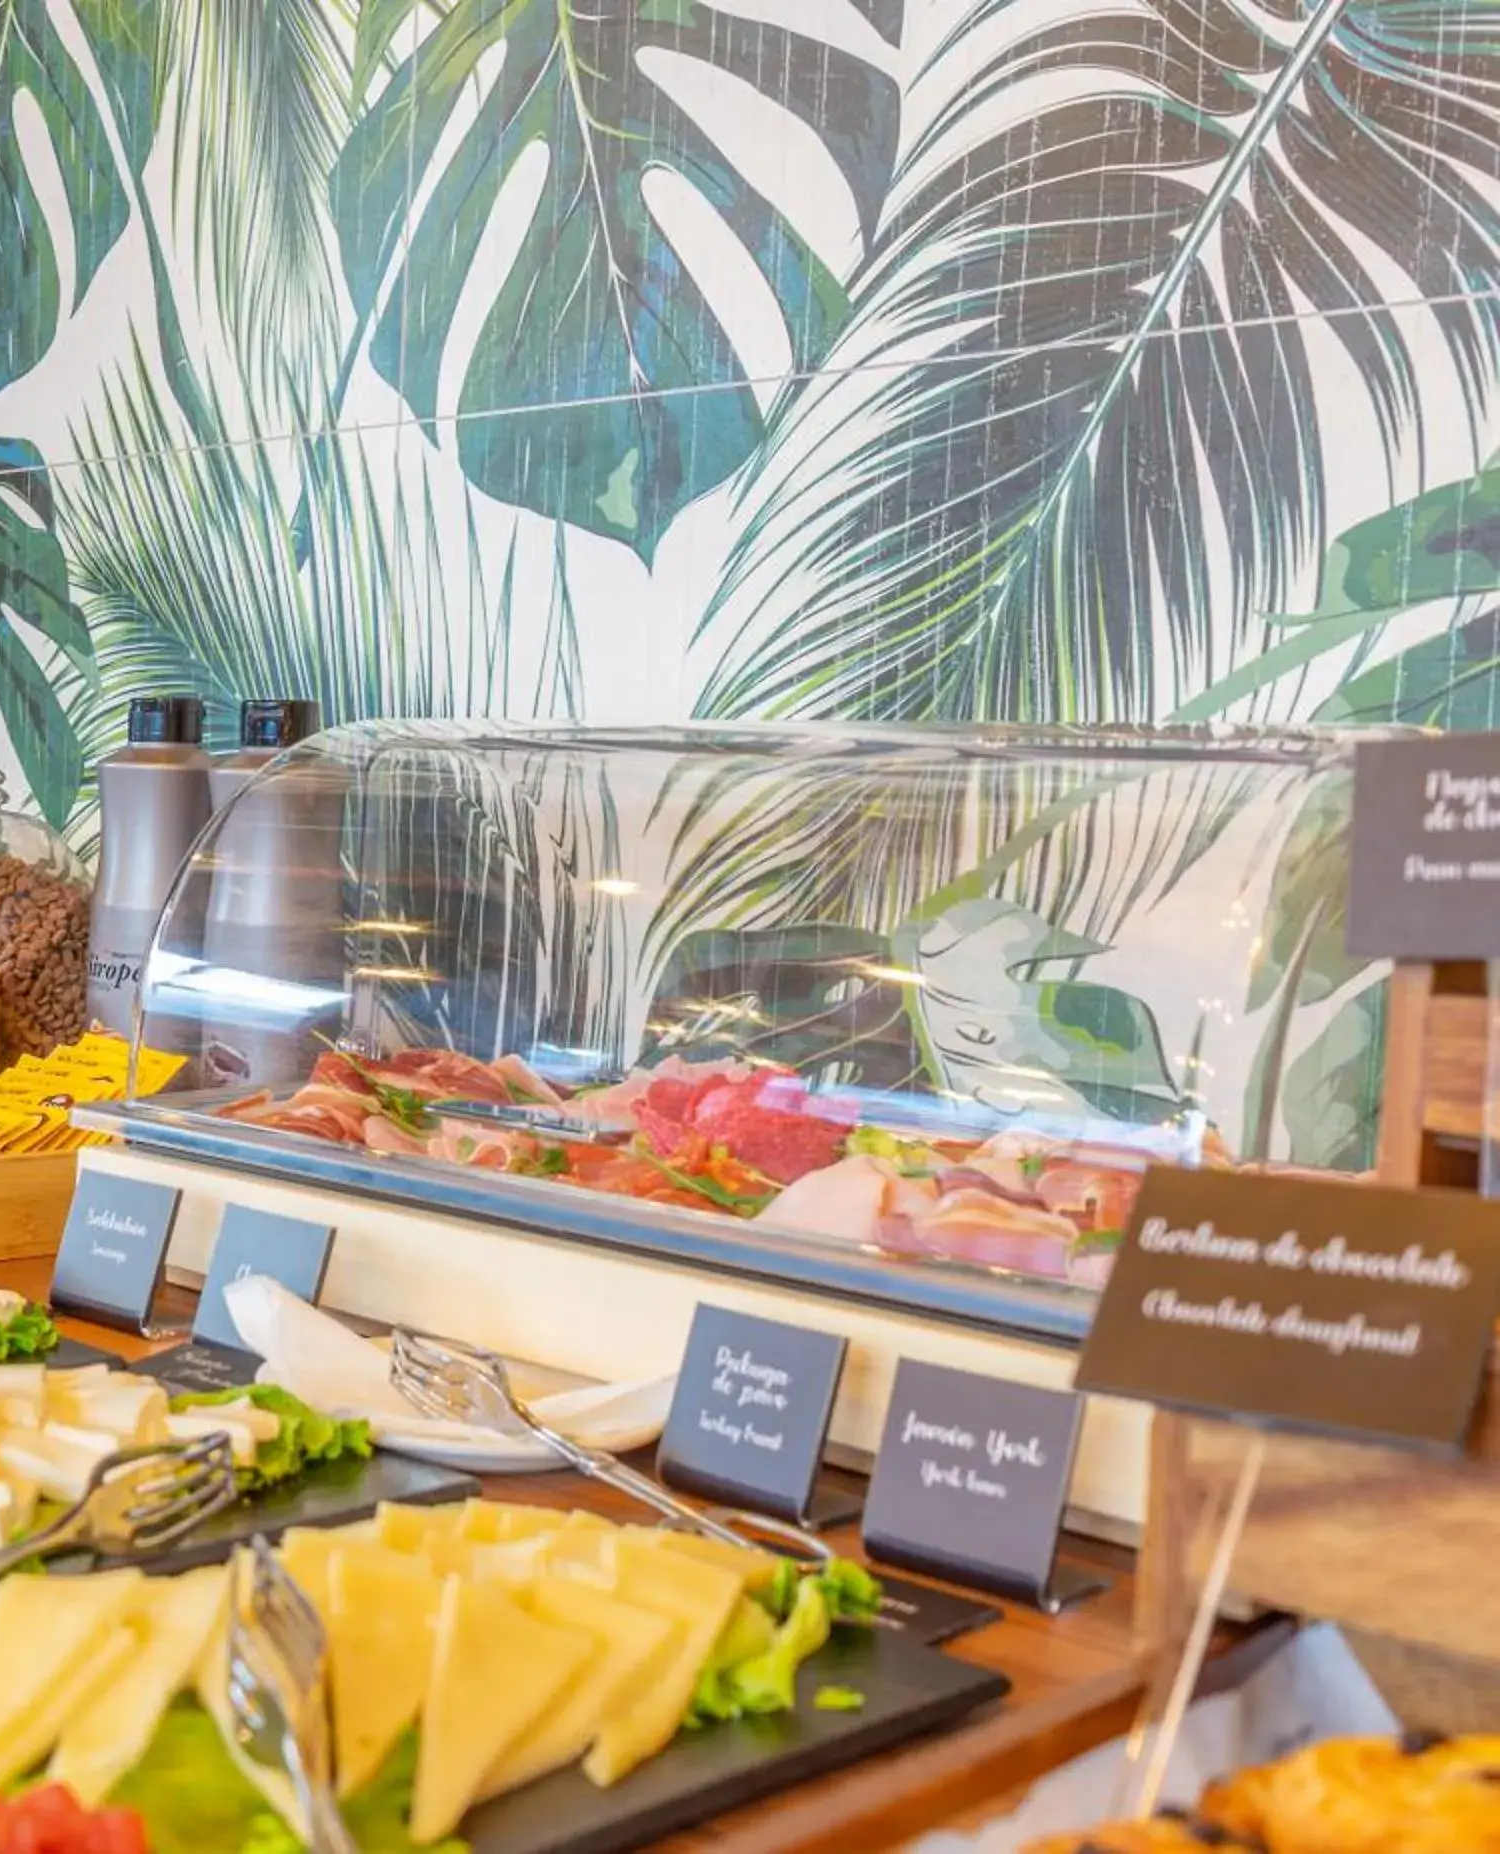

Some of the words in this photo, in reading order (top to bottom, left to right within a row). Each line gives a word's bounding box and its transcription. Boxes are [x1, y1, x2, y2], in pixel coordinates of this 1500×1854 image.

[1263, 1229, 1308, 1271] de
[1309, 1236, 1472, 1291] chocolate
[1141, 1288, 1268, 1334] Chocolate
[711, 1368, 735, 1396] de
[737, 1385, 789, 1412] pavo
[985, 1428, 1048, 1468] York
